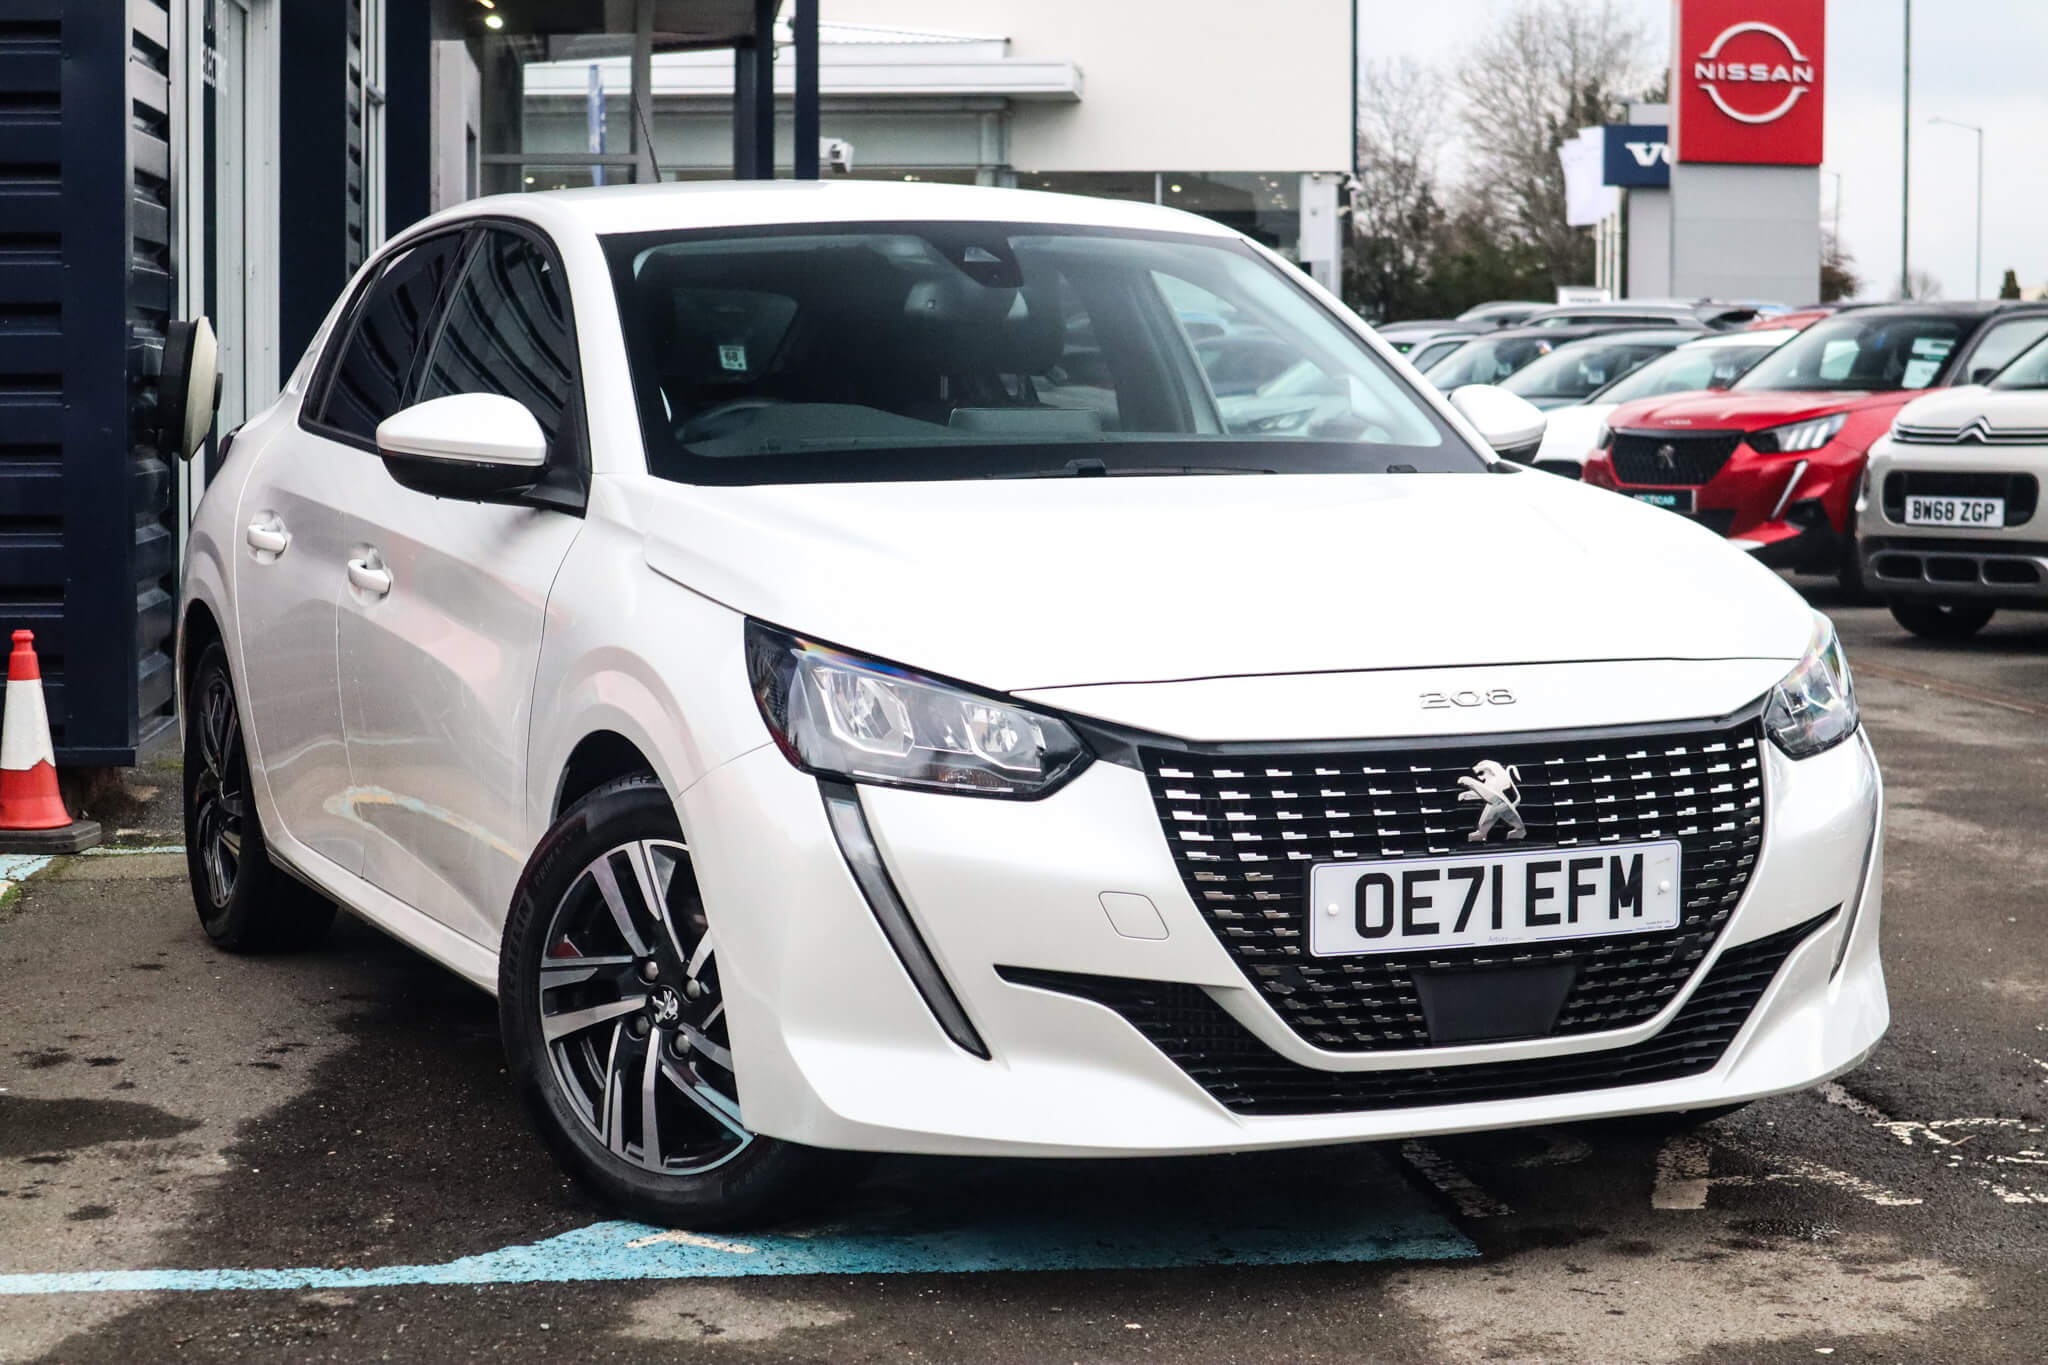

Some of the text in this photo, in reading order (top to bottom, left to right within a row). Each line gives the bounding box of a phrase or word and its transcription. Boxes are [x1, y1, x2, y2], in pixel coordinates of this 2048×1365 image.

[1694, 62, 1814, 83] NISSAN
[1912, 500, 1995, 522] BW68 ZGP
[1419, 688, 1518, 709] 208
[1354, 853, 1645, 939] OE71 EFM
